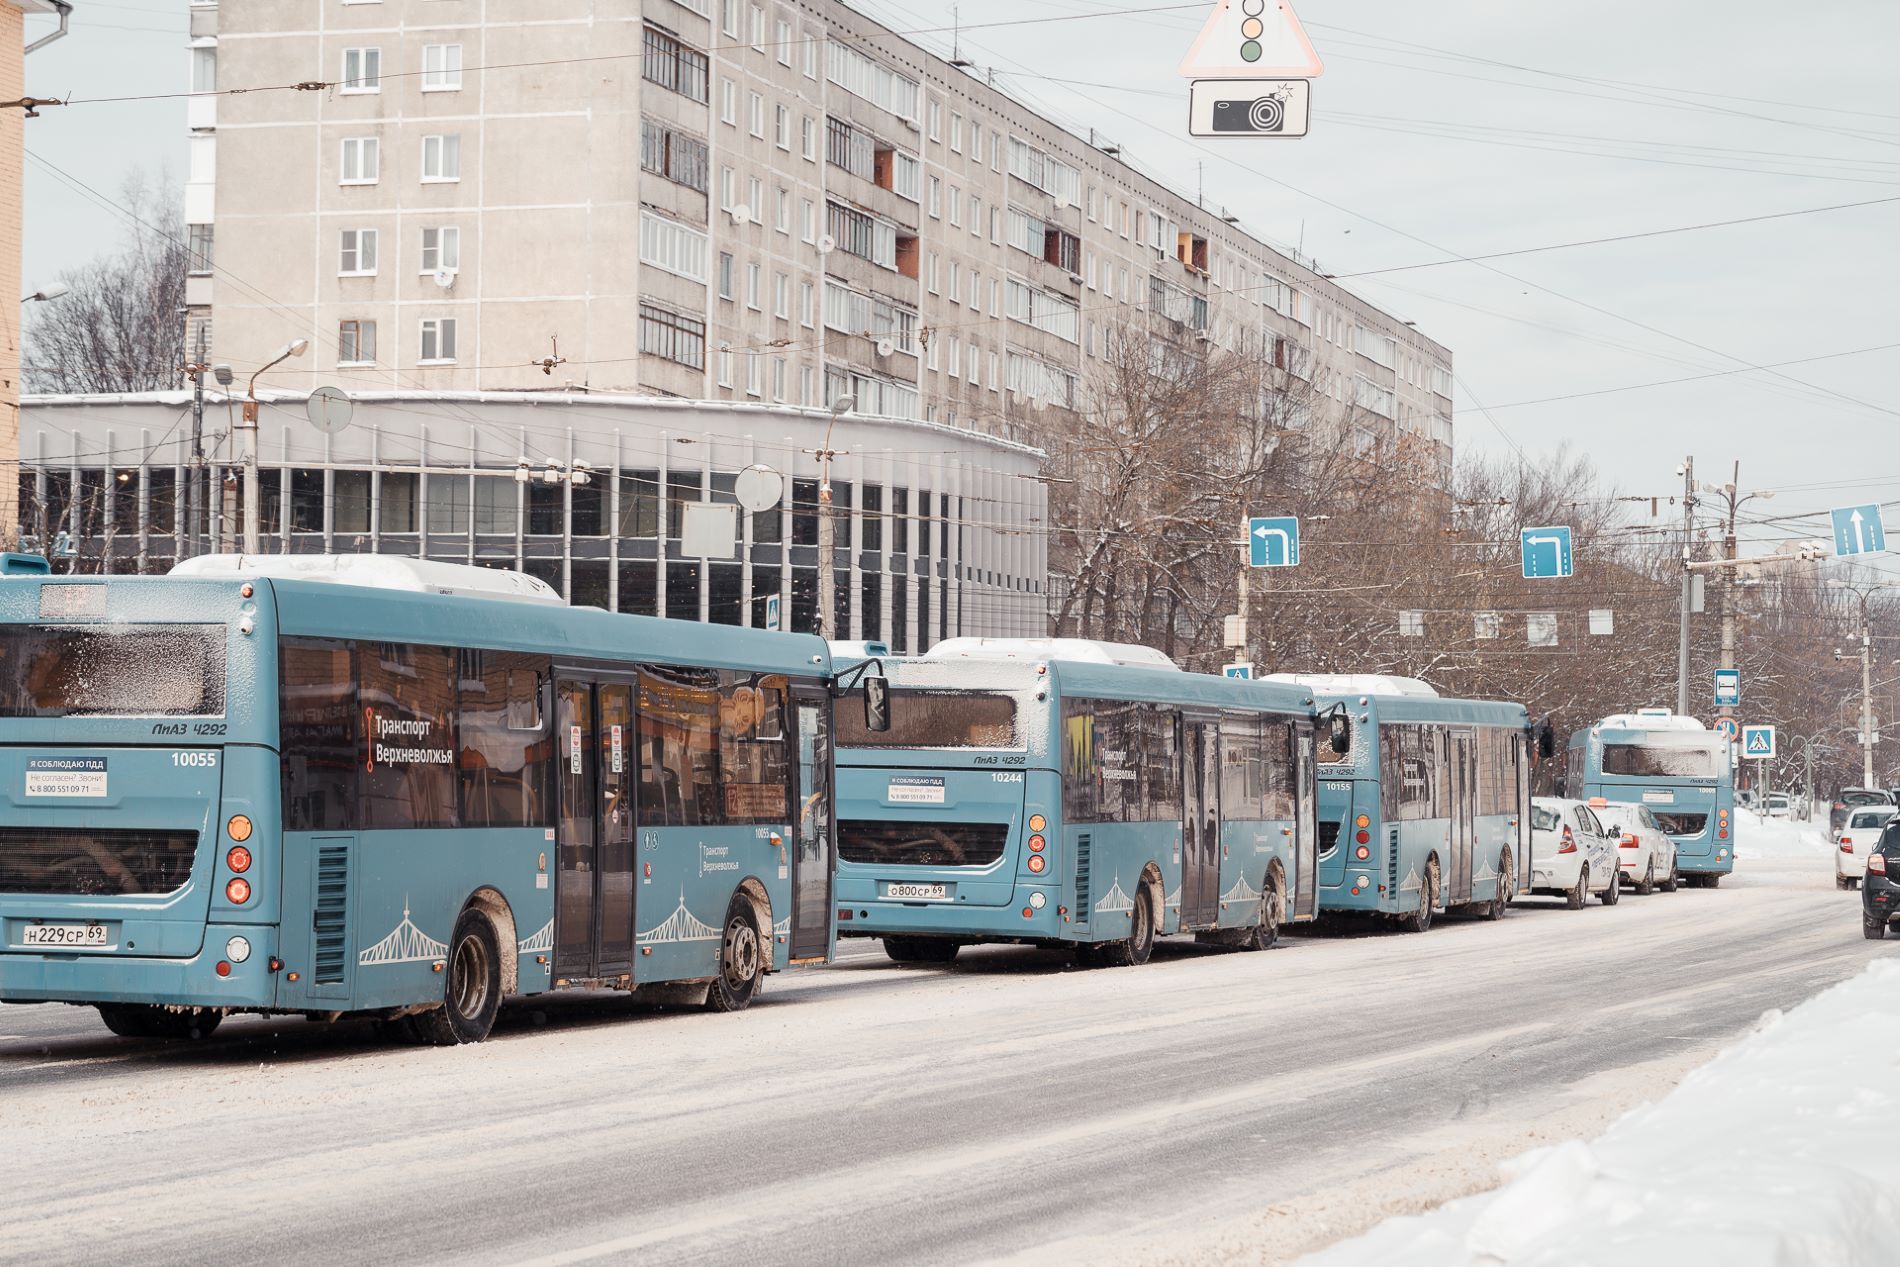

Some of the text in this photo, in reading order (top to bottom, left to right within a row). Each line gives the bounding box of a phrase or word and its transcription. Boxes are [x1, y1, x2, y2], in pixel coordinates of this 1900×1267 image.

[193, 723, 228, 736] 4292
[375, 715, 430, 740] Транспорт
[171, 752, 217, 767] 10055
[376, 743, 453, 768] Верхневолжья
[1002, 756, 1026, 765] 4292
[30, 760, 104, 770] Я СОБЛЮДАЮ ПДД
[991, 773, 1023, 783] 10244
[1326, 783, 1351, 791] 10155
[755, 828, 769, 839] 10055
[703, 845, 729, 858] Транспорт
[891, 886, 943, 896] О800СР 69
[28, 926, 102, 943] Н229СР 69
